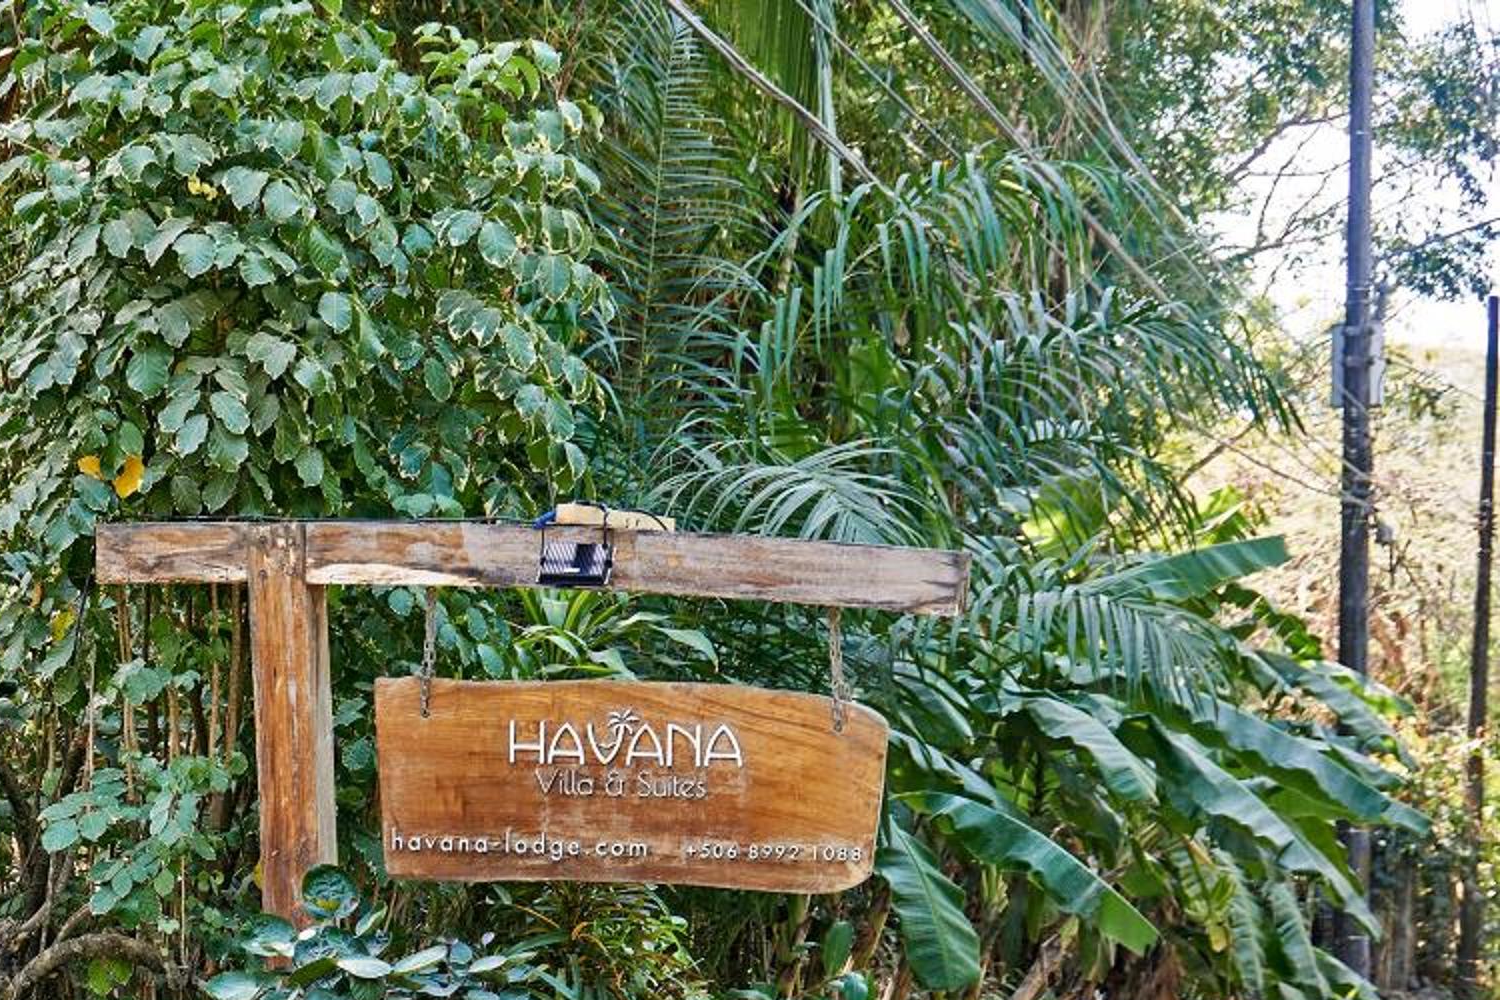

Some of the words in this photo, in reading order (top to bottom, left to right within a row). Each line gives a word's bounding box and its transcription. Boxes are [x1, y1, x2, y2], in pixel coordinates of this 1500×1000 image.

[509, 717, 743, 767] HAVANA
[535, 769, 593, 796] Villa
[605, 771, 623, 797] &
[637, 770, 707, 798] Suites
[391, 827, 647, 861] havana-lodge.com
[686, 843, 738, 860] +506
[748, 844, 800, 861] 8992
[812, 844, 862, 861] 1088
